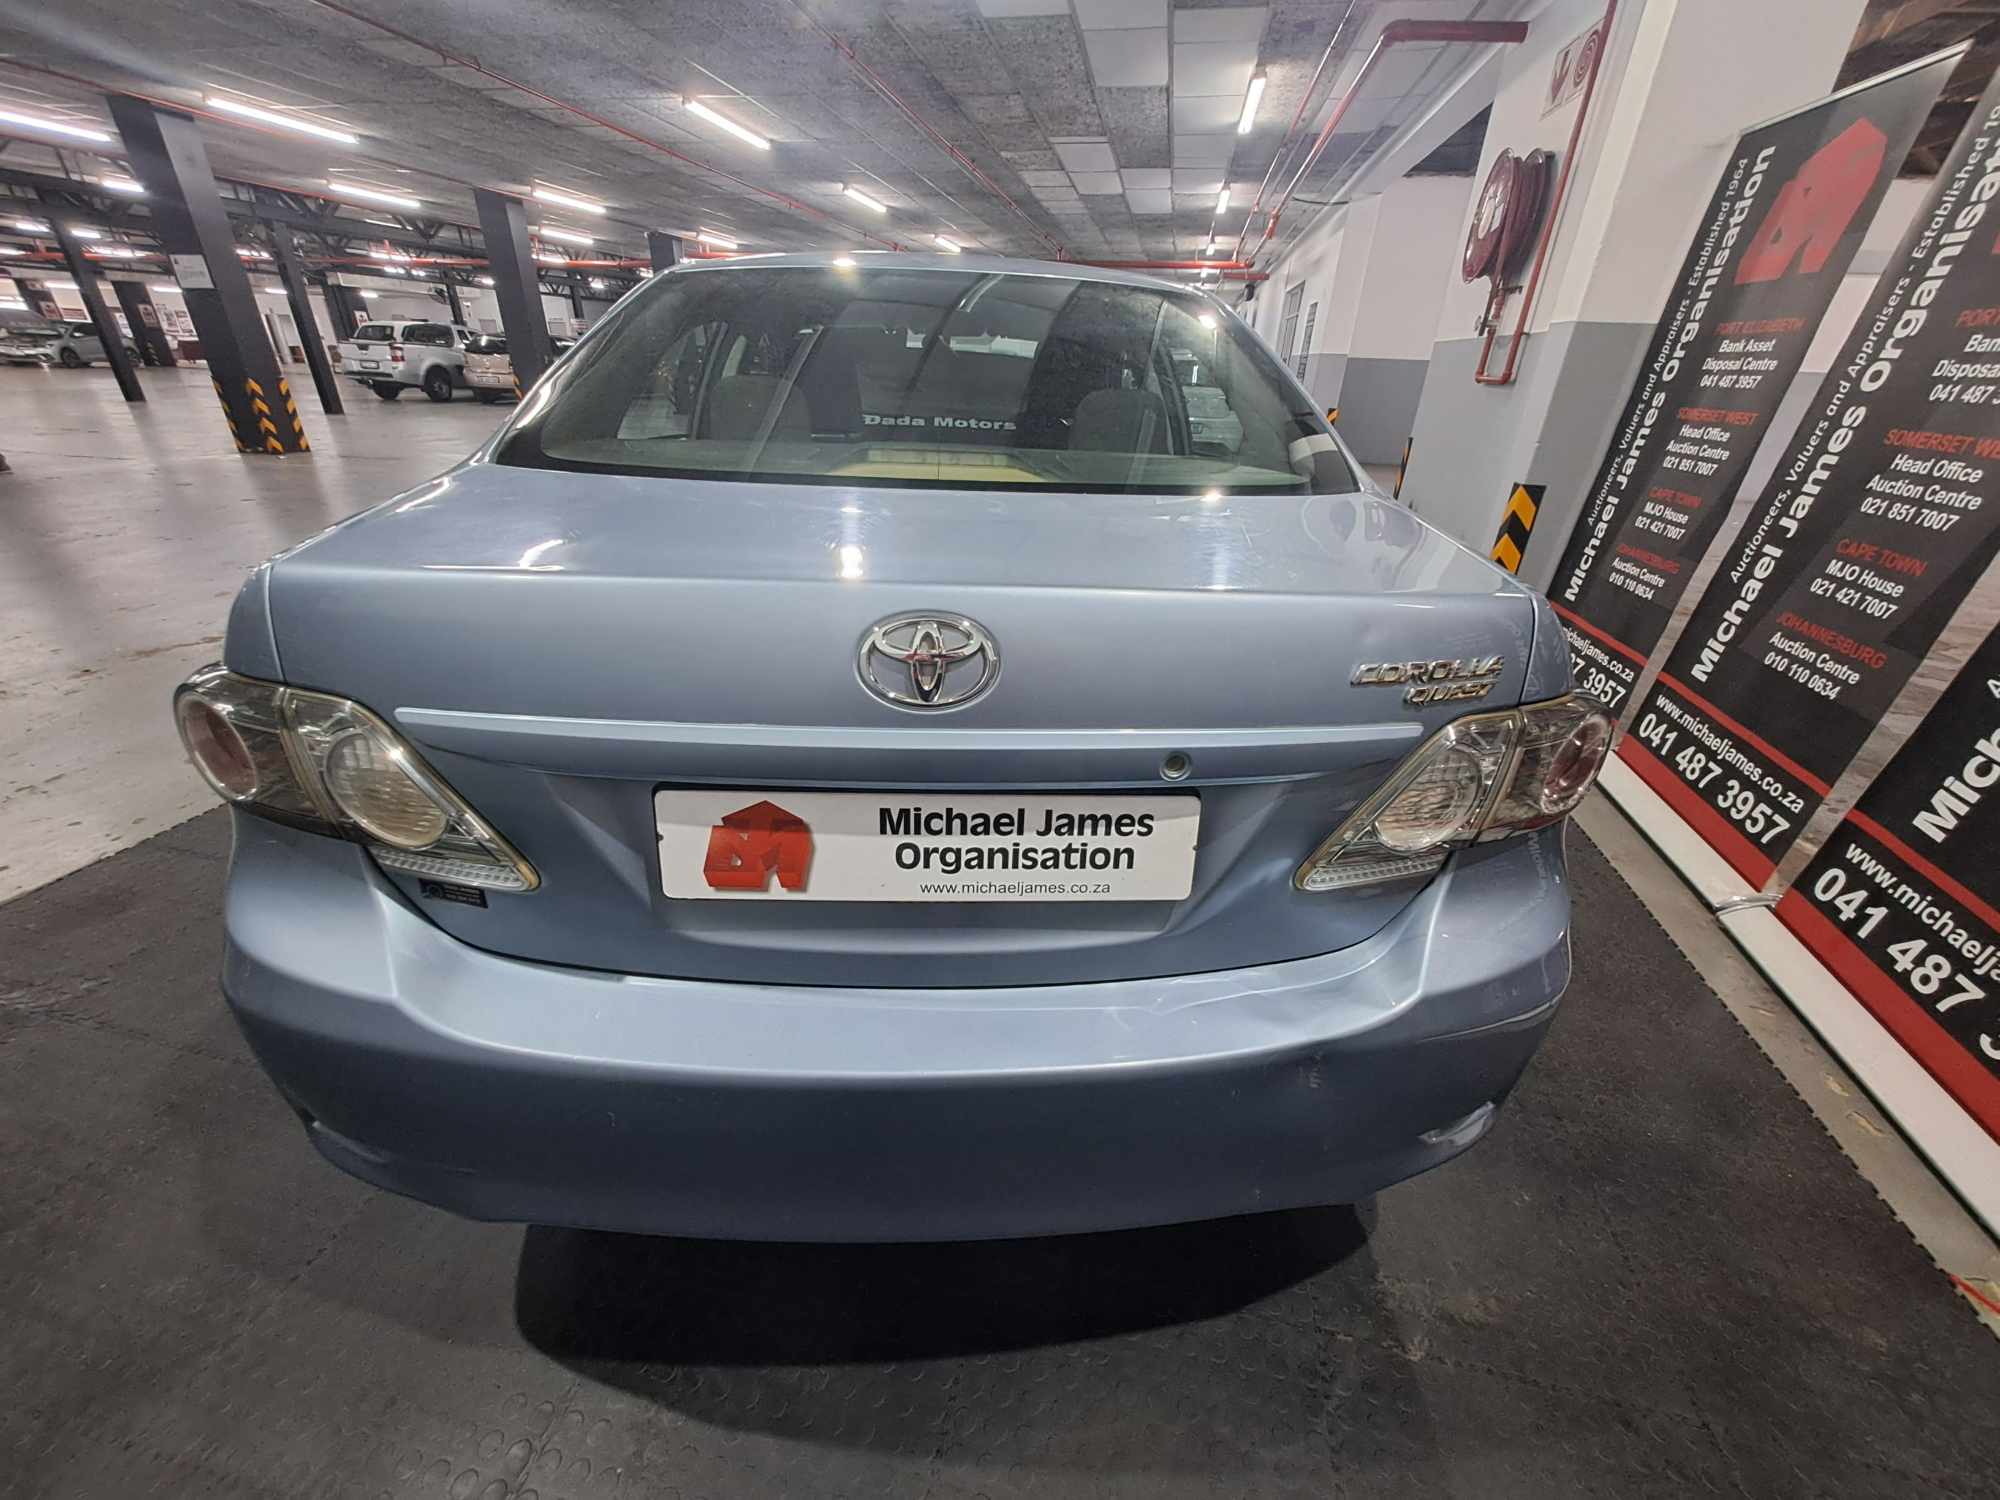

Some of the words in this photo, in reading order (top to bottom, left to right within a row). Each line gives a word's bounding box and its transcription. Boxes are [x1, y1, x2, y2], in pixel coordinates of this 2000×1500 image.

[1587, 453, 1624, 527] Auctioneers,
[1619, 402, 1645, 449] Valuers
[1641, 374, 1658, 400] and
[1653, 299, 1690, 372] Appraisers
[1688, 201, 1731, 287] Established
[1725, 158, 1749, 198] 1964
[1718, 339, 1745, 353] Bank
[1746, 338, 1777, 352] Asset
[1729, 488, 1793, 584] Auctioneers,
[1785, 420, 1829, 482] Valuers
[1826, 380, 1852, 417] and
[1847, 277, 1911, 378] Appraisers
[1911, 137, 1991, 258] Established
[1983, 104, 2000, 130] 19
[1963, 333, 2000, 353] Ban
[1563, 495, 1621, 602] Michael
[1615, 391, 1667, 490] James
[1661, 145, 1777, 382] Organisation
[1700, 375, 1717, 387] 041
[1718, 375, 1737, 388] 487
[1735, 376, 1763, 389] 3957
[1701, 357, 1743, 373] Disposal
[1742, 358, 1779, 371] Centre
[1932, 360, 2000, 381] Disposa
[1691, 543, 1784, 684] Michael
[1778, 405, 1868, 539] James
[1859, 137, 2000, 393] Organisat
[1928, 383, 1962, 402] 041
[1961, 385, 1996, 405] 487
[862, 414, 925, 426] Dada
[933, 416, 1017, 430] Motors
[1679, 424, 1705, 440] Head
[1702, 427, 1731, 442] Office
[1665, 440, 1699, 456] Auction
[1698, 445, 1730, 461] Centre
[1884, 428, 1976, 454] SOMERSET
[1662, 456, 1679, 469] 021
[1678, 459, 1694, 472] 851
[1693, 461, 1719, 477] 7007
[1890, 453, 1934, 475] Head
[1932, 459, 1984, 483] Office
[1865, 474, 1926, 500] Auction
[1924, 484, 1983, 511] Centre
[1634, 515, 1651, 530] 021
[1649, 521, 1665, 535] 421
[1663, 525, 1687, 541] 7007
[1643, 501, 1664, 516] MJO
[1662, 506, 1689, 525] House
[1860, 496, 1890, 515] 021
[1888, 501, 1917, 523] 851
[1915, 507, 1960, 532] 7007
[1612, 557, 1643, 577] Auction
[1639, 568, 1666, 588] Centre
[1835, 538, 1880, 561] CAPE
[1880, 550, 1929, 577] TOWN
[1825, 559, 1861, 582] MJO
[1858, 571, 1905, 597] House
[1809, 578, 1839, 599] 021
[1834, 586, 1863, 608] 421
[1859, 595, 1898, 620] 7007
[1562, 626, 1635, 683] michaeljames.co.za
[1775, 611, 1888, 669] JOHANNESBURG
[1351, 656, 1505, 687] COROLLA
[1769, 631, 1817, 662] Auction
[1815, 652, 1861, 686] Centre
[1583, 667, 1627, 708] 3957
[1763, 651, 1788, 672] 010
[1788, 663, 1809, 684] 110
[1807, 674, 1841, 701] 0634
[1655, 693, 1805, 815] www.michaeljames.co.za
[1638, 713, 1678, 756] 041
[1675, 745, 1723, 789] 487
[1716, 780, 1791, 844] 3957
[1912, 727, 2000, 844] Mich
[878, 807, 1025, 836] Michael
[1036, 808, 1155, 837] James
[895, 841, 1135, 875] Organisation
[919, 880, 1111, 896] www.michaeljames.co.za
[1813, 867, 1889, 940] 041
[1886, 938, 1987, 1014] 487
